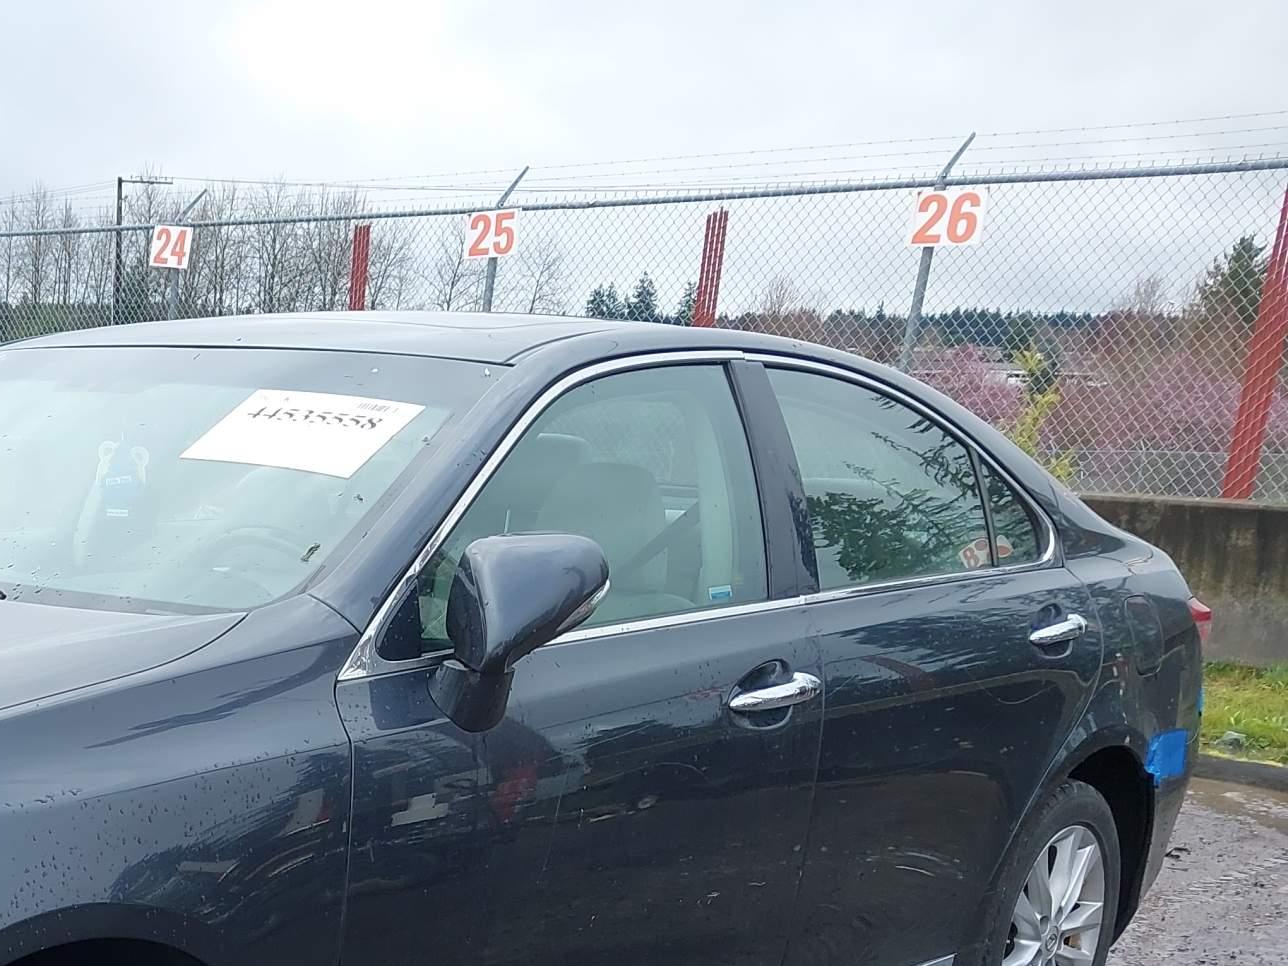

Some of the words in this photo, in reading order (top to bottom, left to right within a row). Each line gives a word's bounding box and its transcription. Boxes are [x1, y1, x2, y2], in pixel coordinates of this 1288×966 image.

[468, 211, 515, 257] 25
[911, 192, 981, 244] 26
[153, 228, 188, 266] 24
